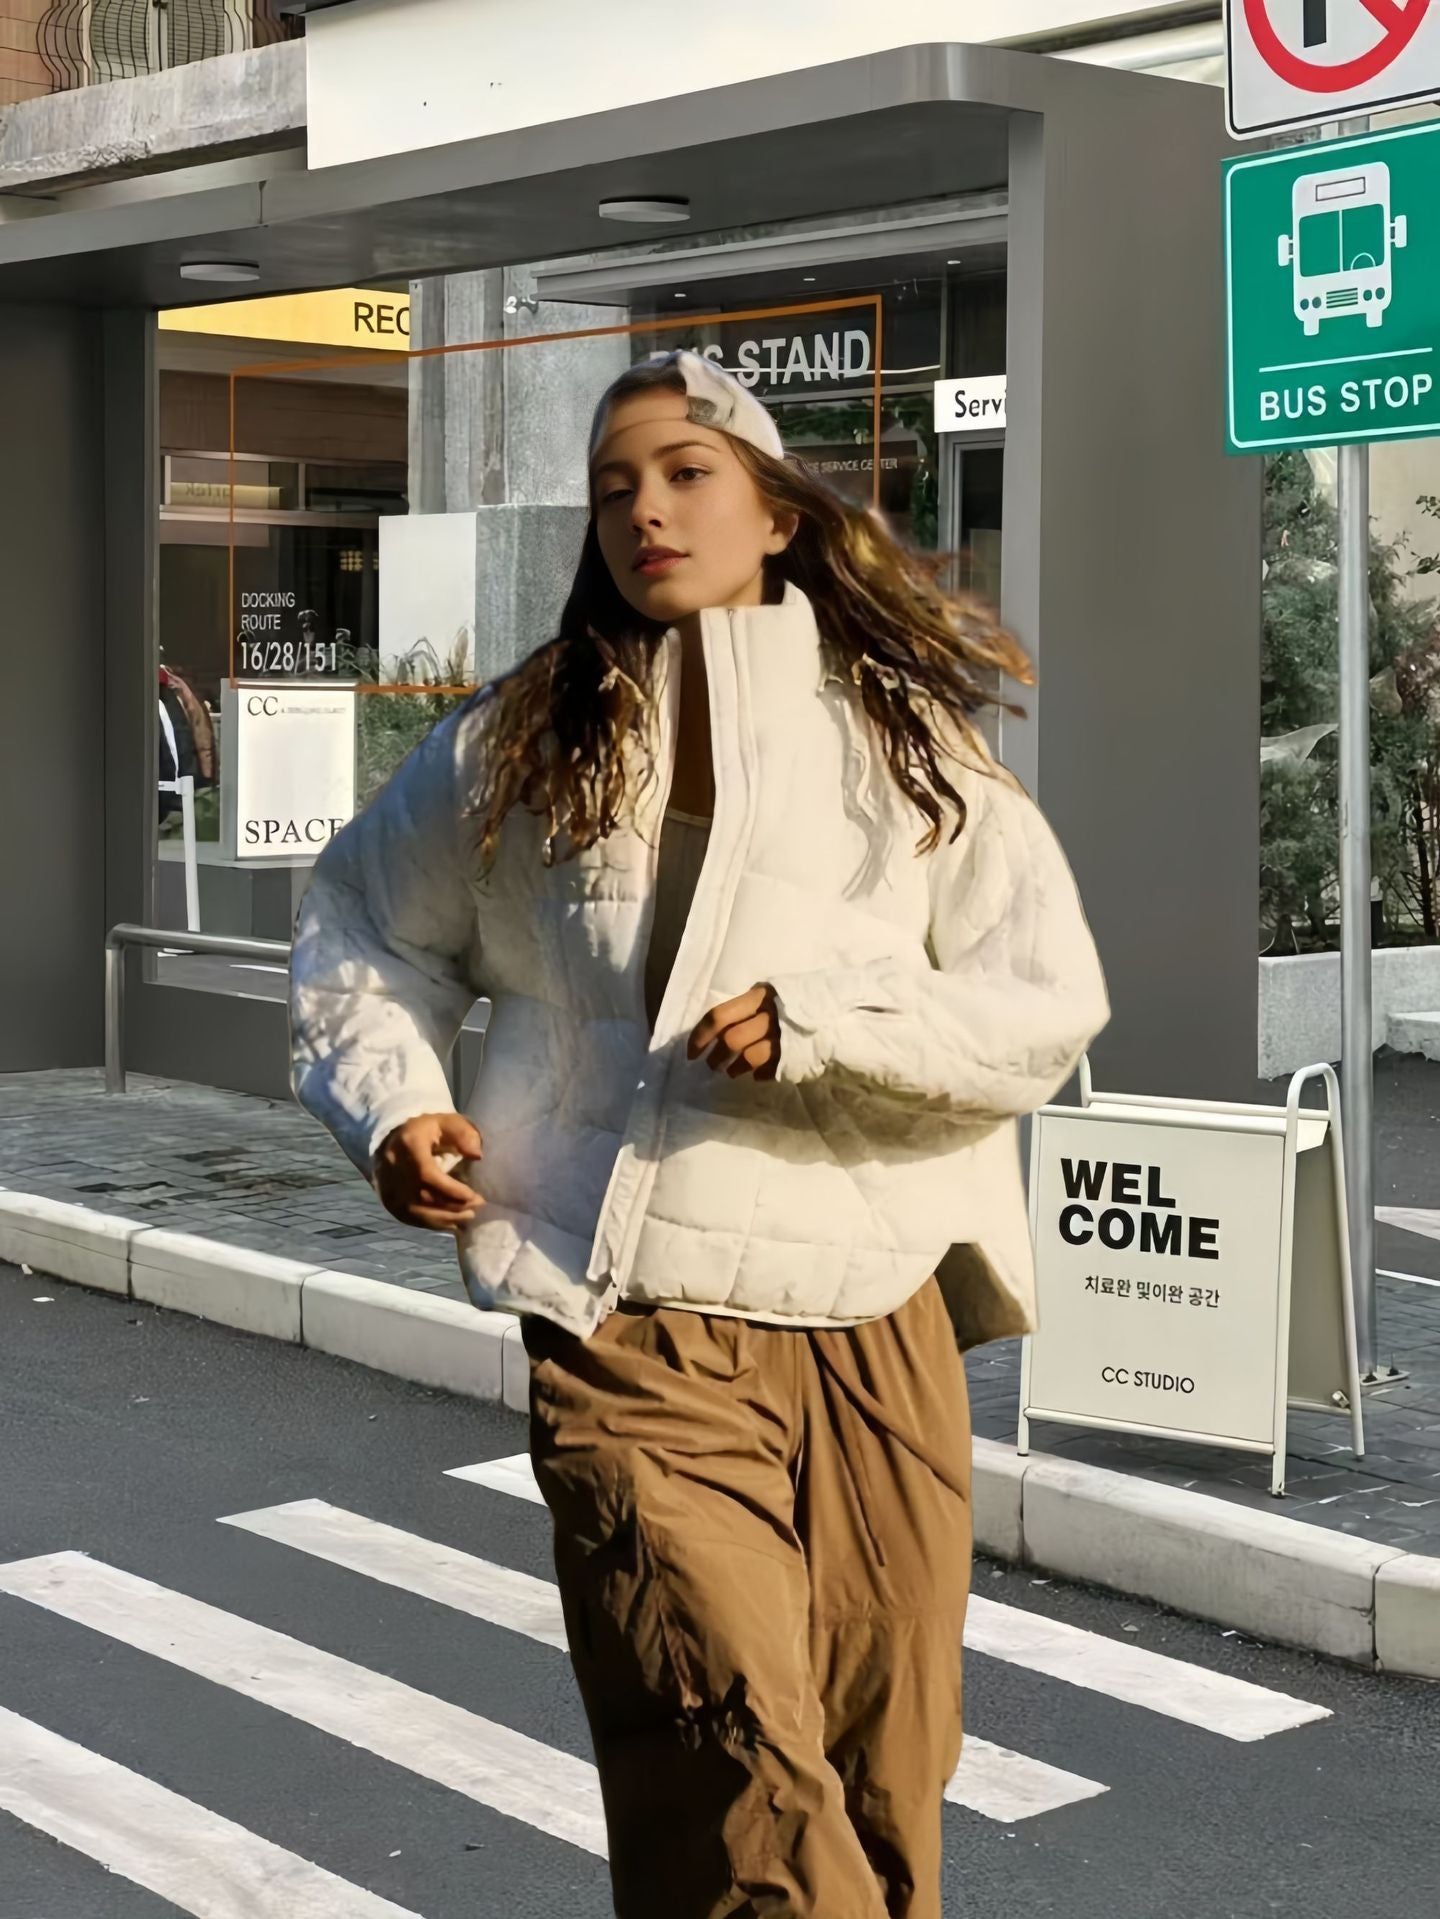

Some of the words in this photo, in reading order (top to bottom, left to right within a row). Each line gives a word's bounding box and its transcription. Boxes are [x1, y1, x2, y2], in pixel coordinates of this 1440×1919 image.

[736, 329, 871, 388] STAND
[1260, 384, 1327, 421] BUS
[1340, 373, 1433, 413] STOP
[860, 458, 898, 471] CETER
[241, 592, 296, 608] DOCKING
[241, 614, 281, 630] ROUTE
[240, 641, 337, 675] 16/28/151
[247, 695, 279, 717] CC
[1060, 1157, 1176, 1209] WEL
[1058, 1203, 1220, 1260] COME
[1188, 1286, 1220, 1308] 공간
[1101, 1366, 1129, 1385] CC
[1133, 1370, 1195, 1394] STUDIO
